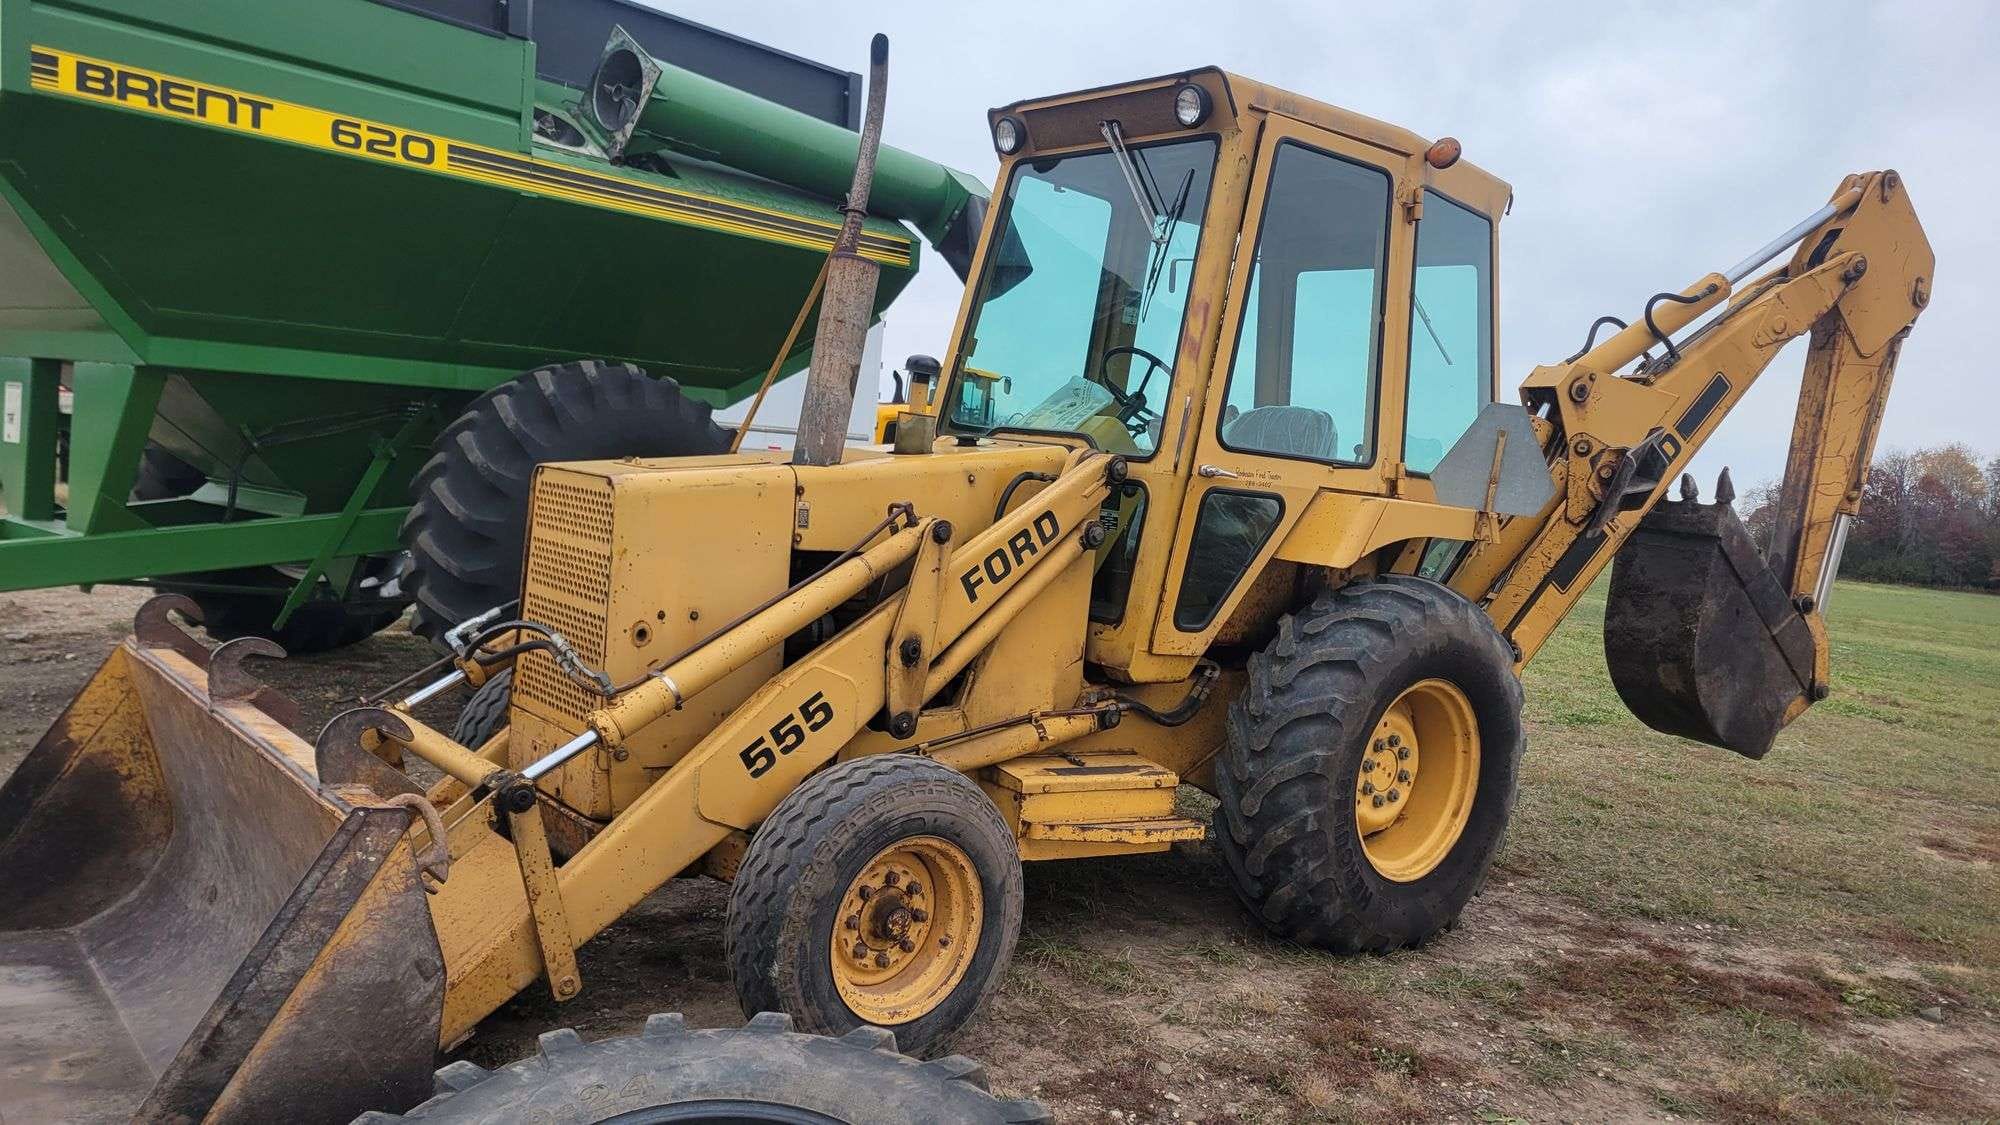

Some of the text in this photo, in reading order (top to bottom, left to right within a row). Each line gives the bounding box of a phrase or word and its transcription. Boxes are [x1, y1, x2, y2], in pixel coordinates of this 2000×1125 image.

[76, 60, 435, 166] BRENT 620
[960, 510, 1060, 604] FORD
[739, 690, 834, 779] 555
